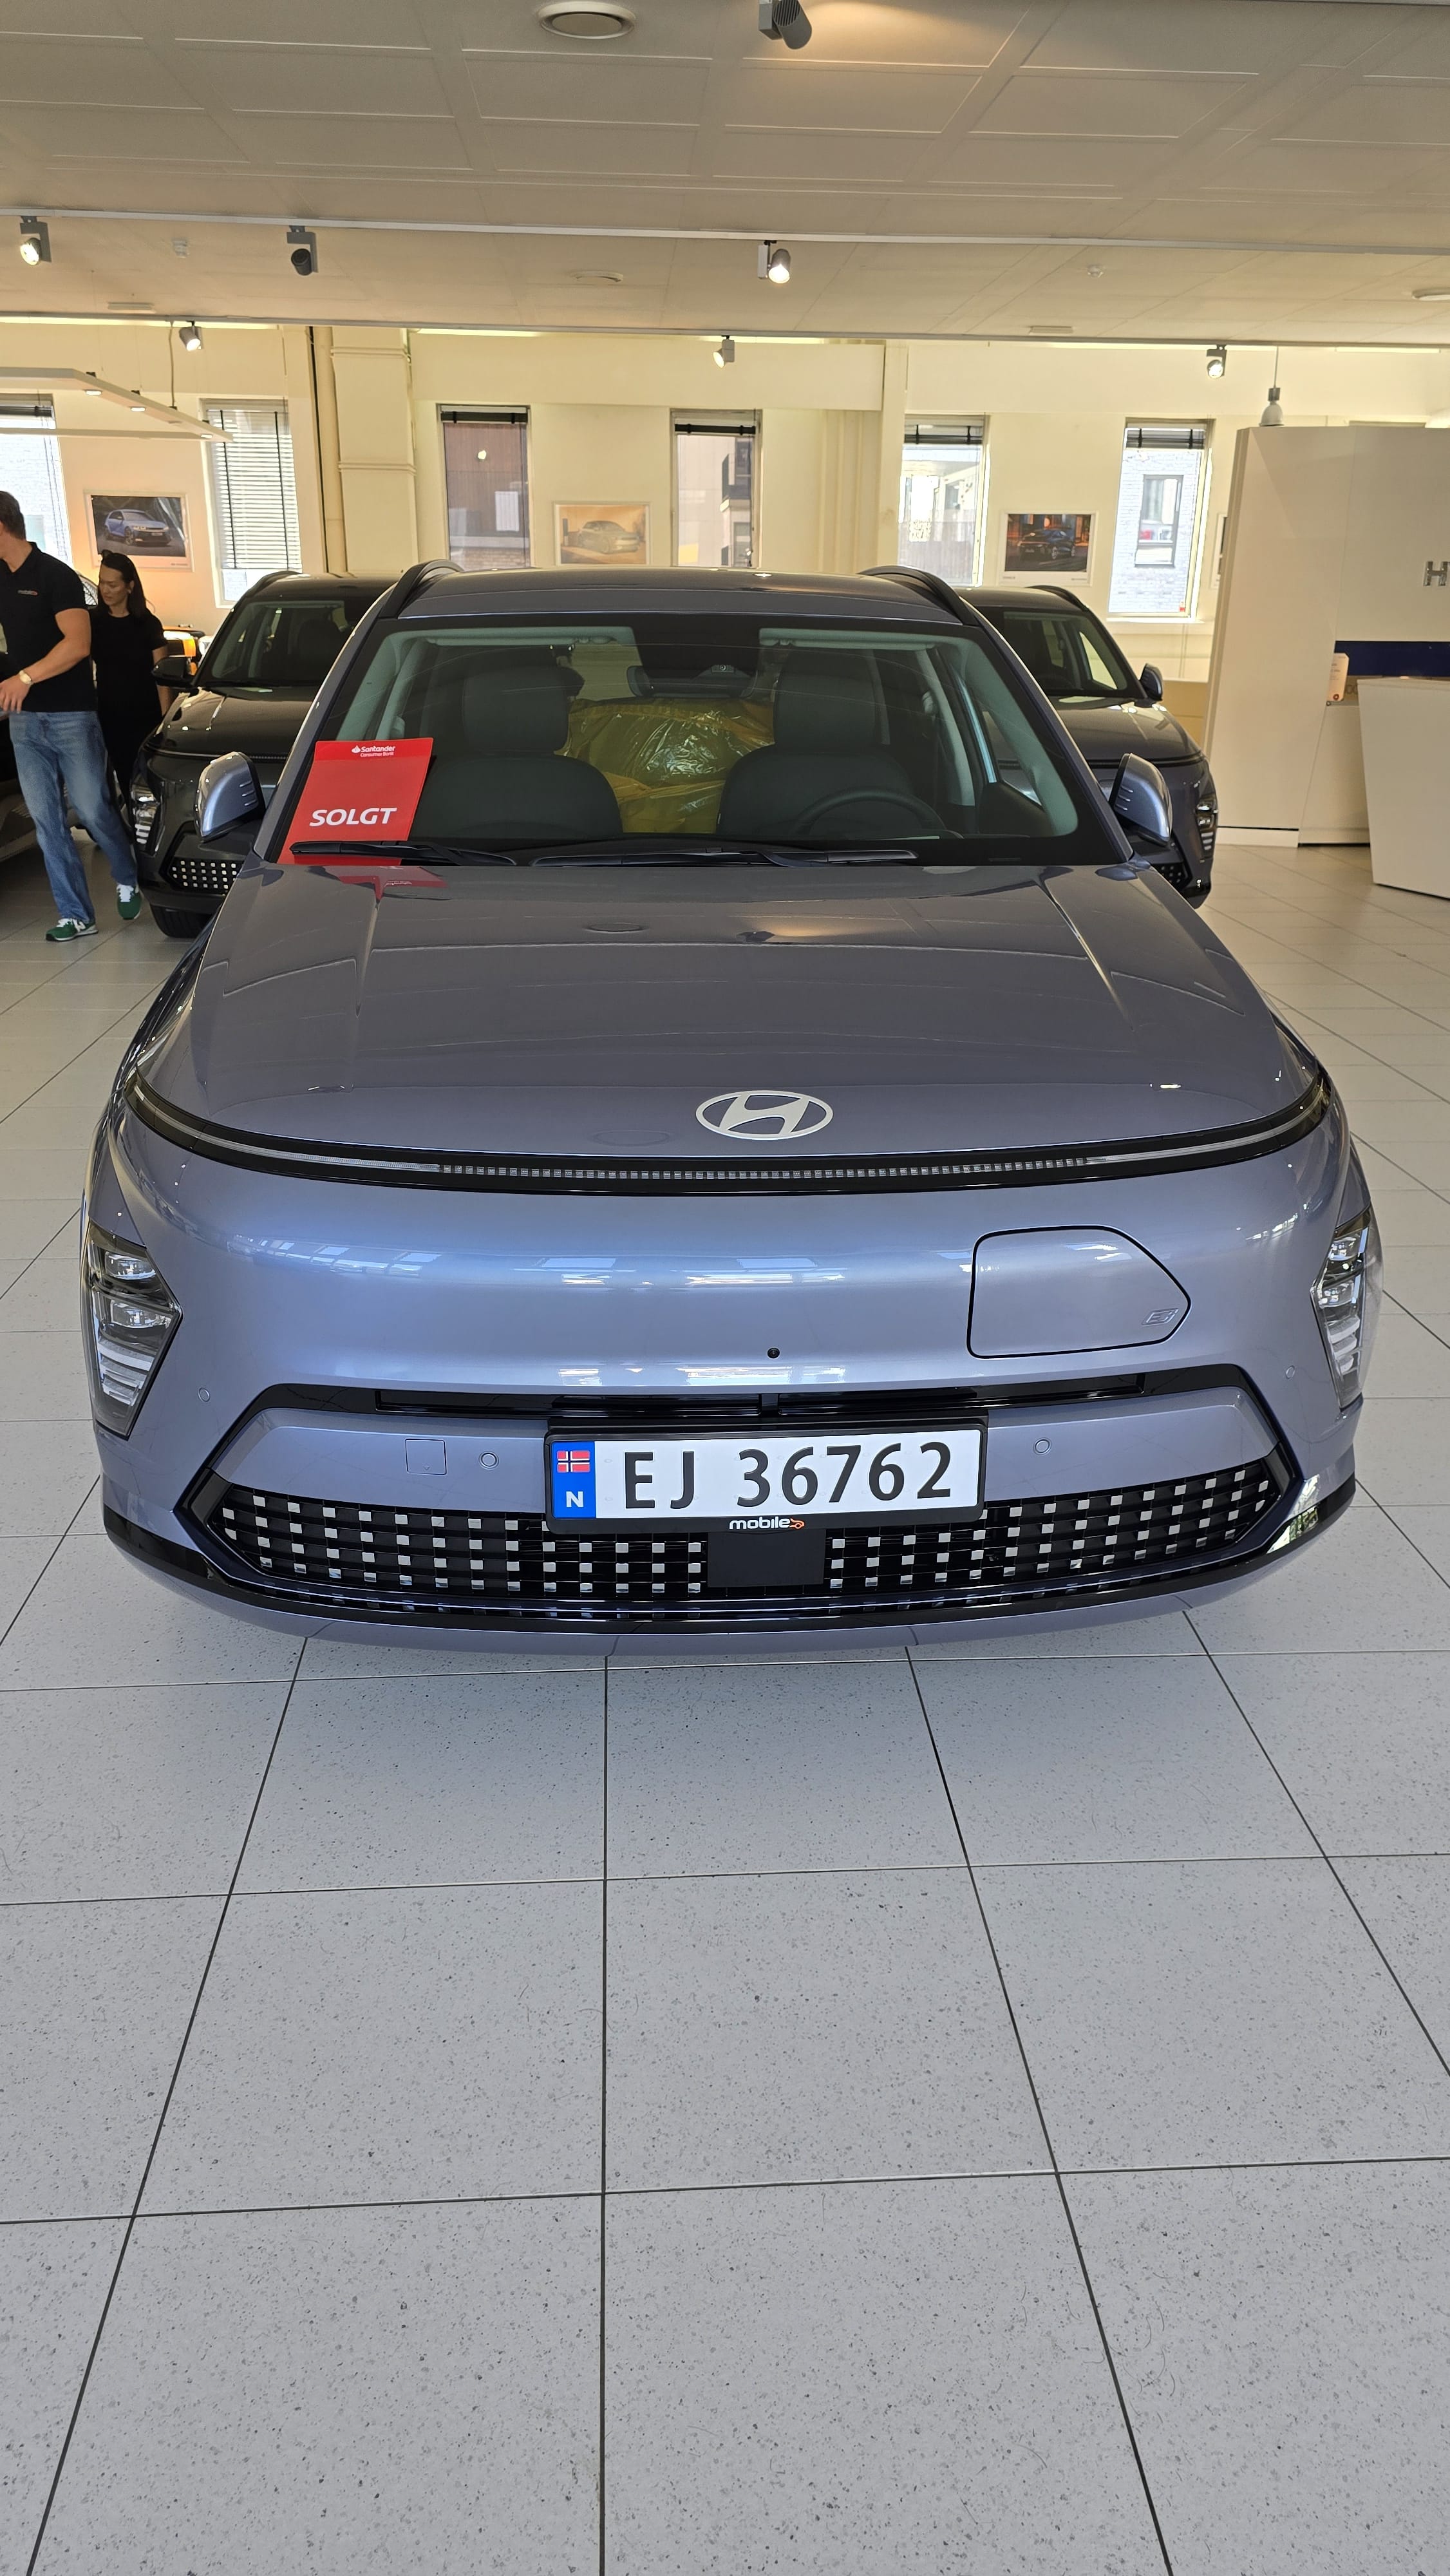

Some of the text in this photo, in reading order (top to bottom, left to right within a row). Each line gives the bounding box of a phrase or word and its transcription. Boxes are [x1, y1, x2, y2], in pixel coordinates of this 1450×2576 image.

[1423, 561, 1450, 586] H
[309, 808, 397, 826] SOLGT
[625, 1441, 952, 1509] EJ 36762
[566, 1491, 584, 1508] N
[729, 1516, 791, 1530] mobile
